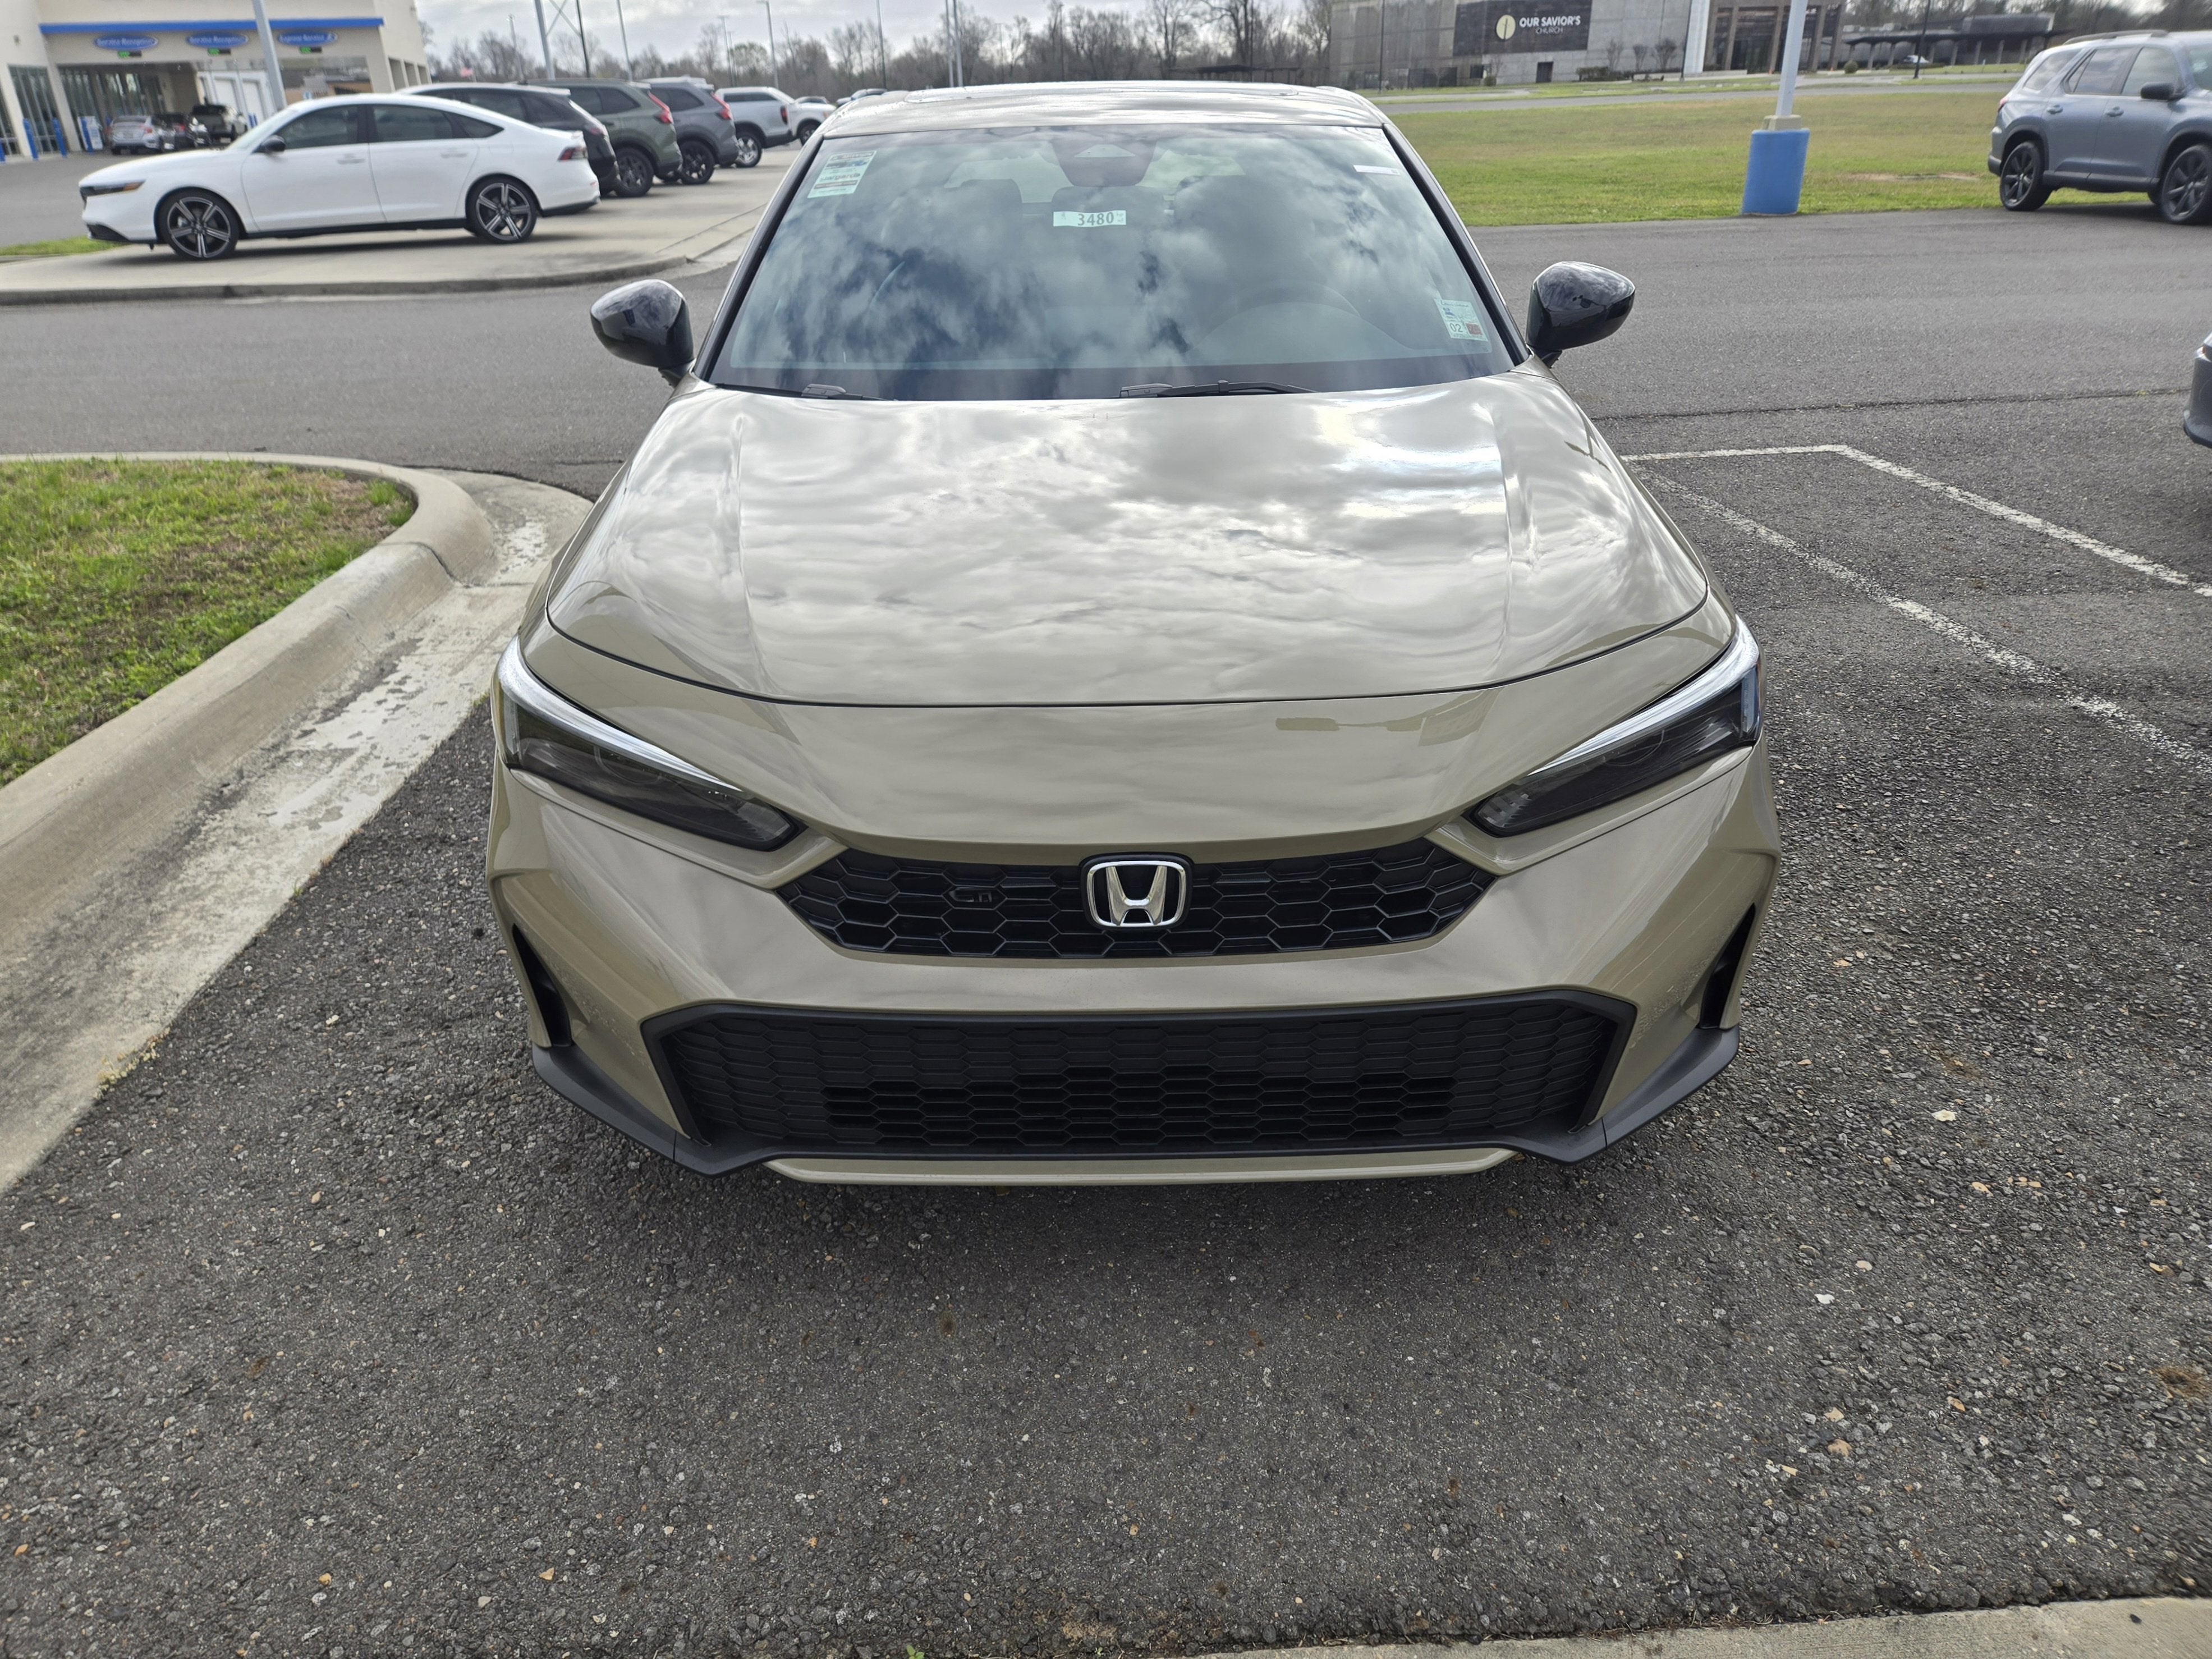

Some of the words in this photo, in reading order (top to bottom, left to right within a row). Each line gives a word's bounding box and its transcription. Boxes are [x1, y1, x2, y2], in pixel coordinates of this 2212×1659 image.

[1519, 17, 1539, 28] OUR
[1541, 15, 1581, 27] SAVIOR'S
[1077, 212, 1114, 226] 3480
[1449, 323, 1463, 333] 02
